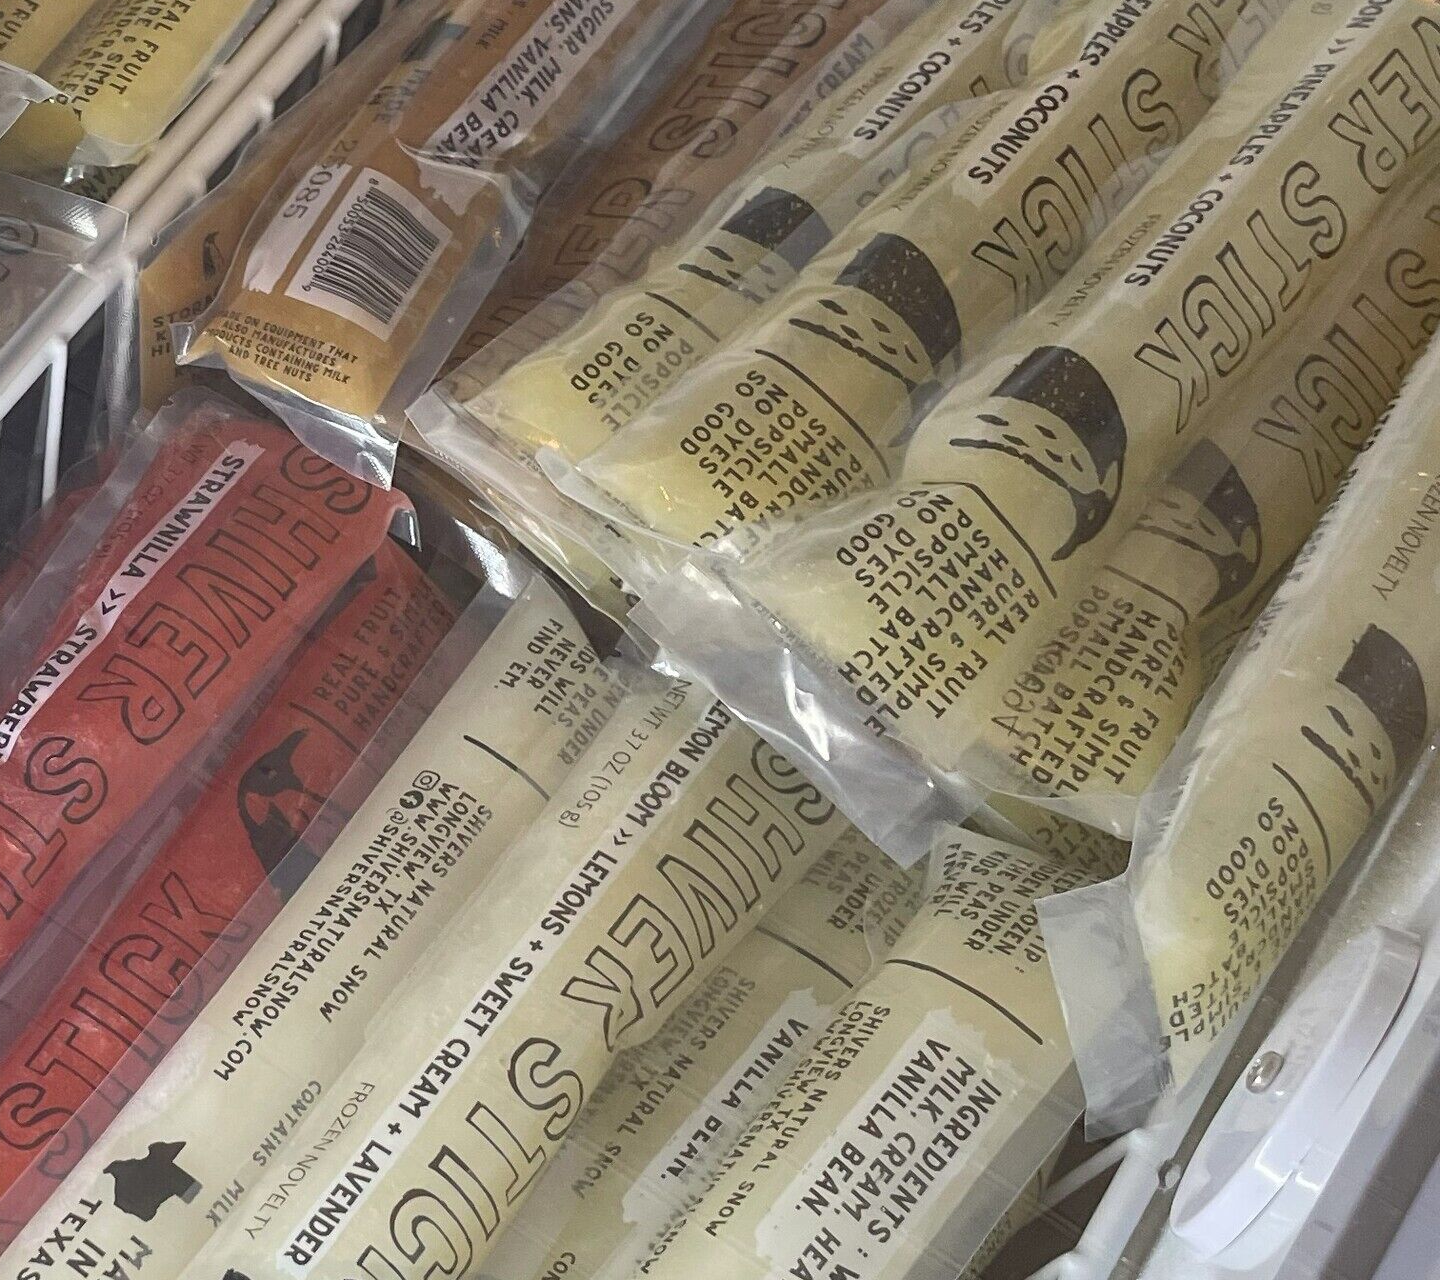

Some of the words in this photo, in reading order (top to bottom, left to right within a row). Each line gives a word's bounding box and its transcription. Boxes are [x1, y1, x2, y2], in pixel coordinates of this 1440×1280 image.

[109, 38, 158, 95] FRUIT
[479, 35, 550, 113] VANILLA
[850, 43, 952, 150] COCONUTS
[964, 77, 1071, 189] COCONUTS
[1116, 162, 1363, 430] STICK
[751, 381, 788, 418] NO
[696, 418, 753, 476] DYES
[711, 399, 807, 497] POPSICLE
[756, 417, 827, 489] SMALL
[118, 449, 244, 588] STRAWNILLA
[76, 433, 376, 754] SHIVER
[983, 587, 1042, 647] REAL
[522, 632, 577, 695] NEVER
[530, 671, 574, 720] WILL
[923, 650, 988, 717] FRUIT
[1102, 709, 1162, 783] FRUIT
[391, 788, 476, 890] LONGVIEW,
[426, 800, 494, 880] SHIVERS
[1254, 795, 1288, 833] SO
[1267, 817, 1301, 855] NO
[371, 884, 401, 916] TX
[551, 738, 835, 1060] SHIVER
[1204, 834, 1259, 902] GOOD
[1220, 858, 1274, 922] DYES
[361, 875, 435, 963] NATURAL
[314, 961, 369, 1024] SNOW
[720, 1013, 808, 1114] VANILLA
[822, 1000, 891, 1083] SHIVERS
[250, 1077, 322, 1167] CONTAINS
[308, 1076, 374, 1157] FROZEN
[856, 1032, 951, 1144] VANILLA
[747, 1081, 828, 1179] NATURAL
[202, 1178, 245, 1227] MILK
[240, 1148, 318, 1243] NOVELTY
[702, 1175, 756, 1239] SNOW
[792, 1138, 868, 1226] BEAN.
[64, 1235, 107, 1280] IN
